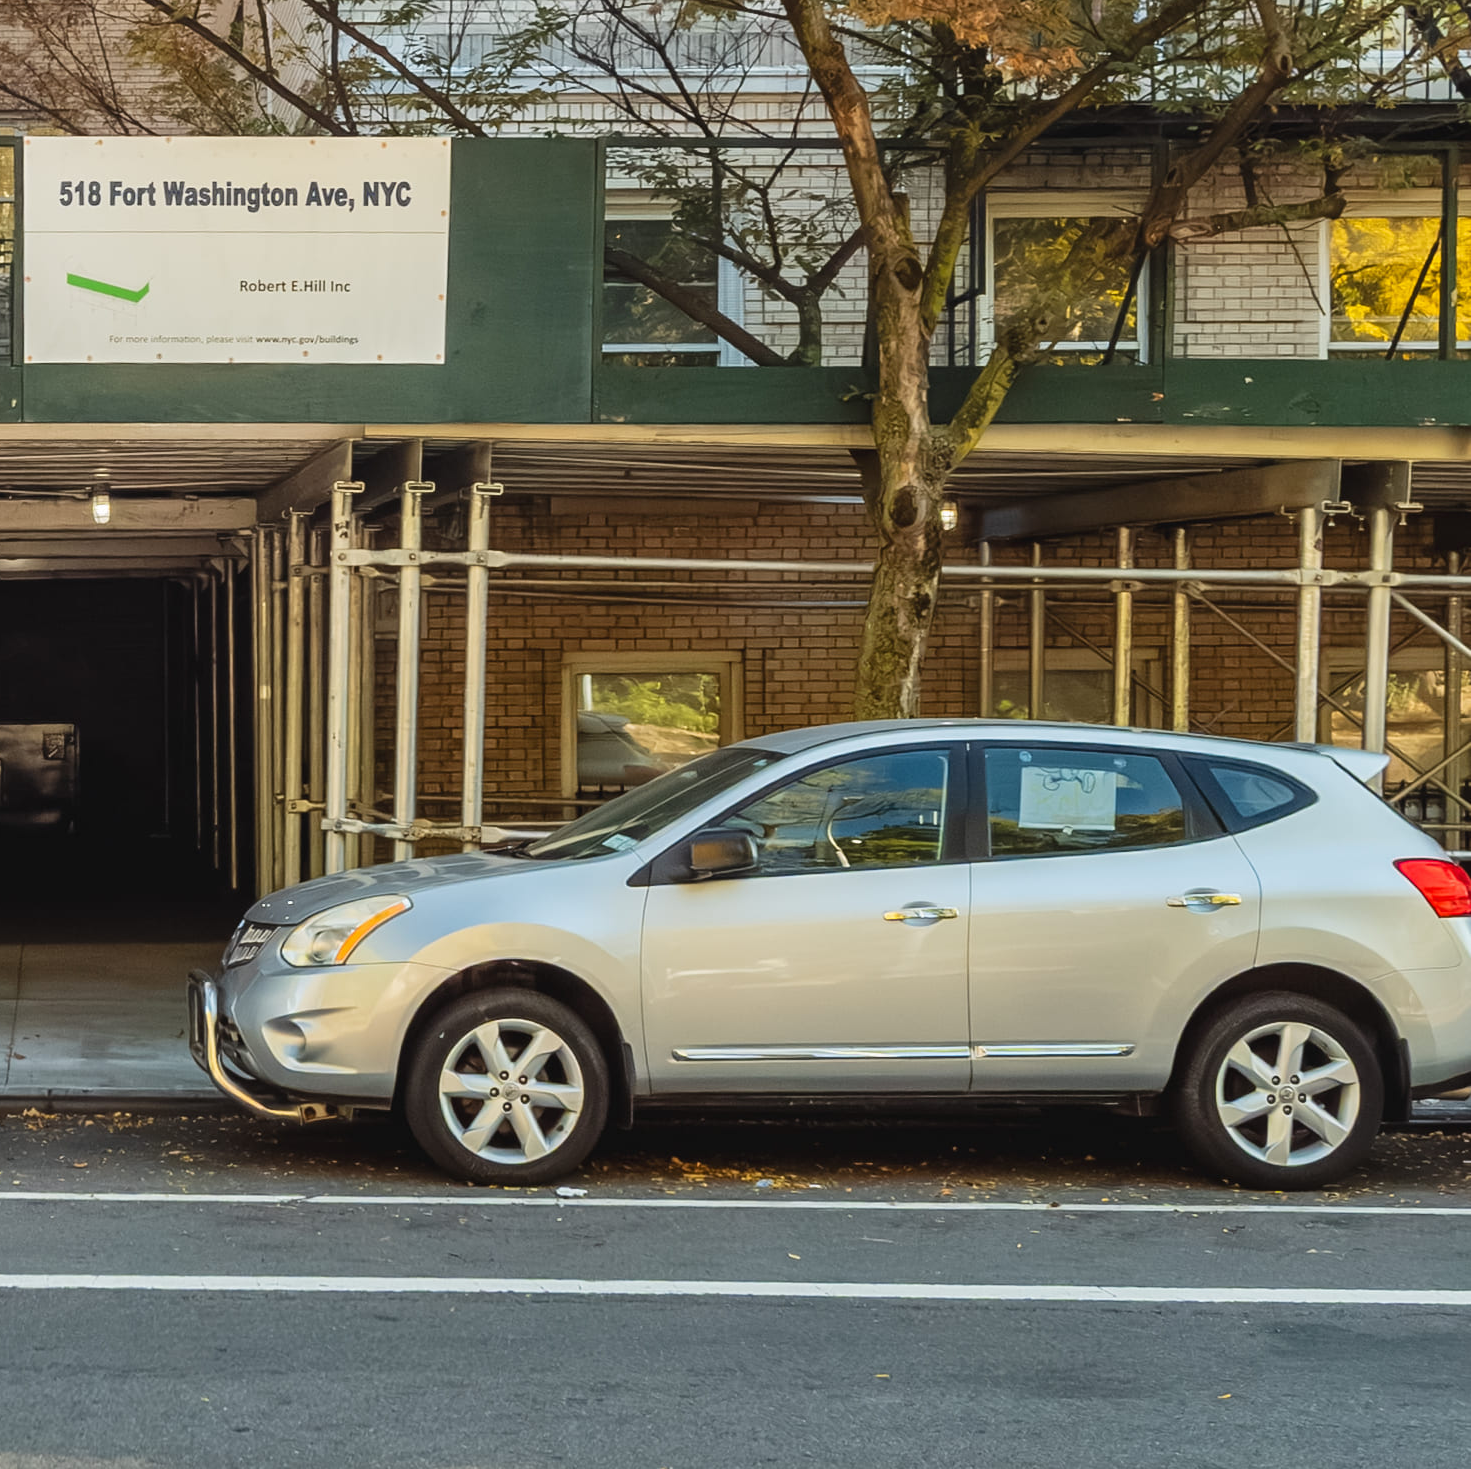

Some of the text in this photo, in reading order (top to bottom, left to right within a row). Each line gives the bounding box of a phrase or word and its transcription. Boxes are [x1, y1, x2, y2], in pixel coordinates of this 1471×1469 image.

[59, 180, 412, 213] 518 Fort Washington Ave, NYC
[239, 279, 287, 293] Robert
[330, 279, 351, 293] Inc
[108, 334, 360, 346] For more information, please visit www.nyc.gov/buildings
